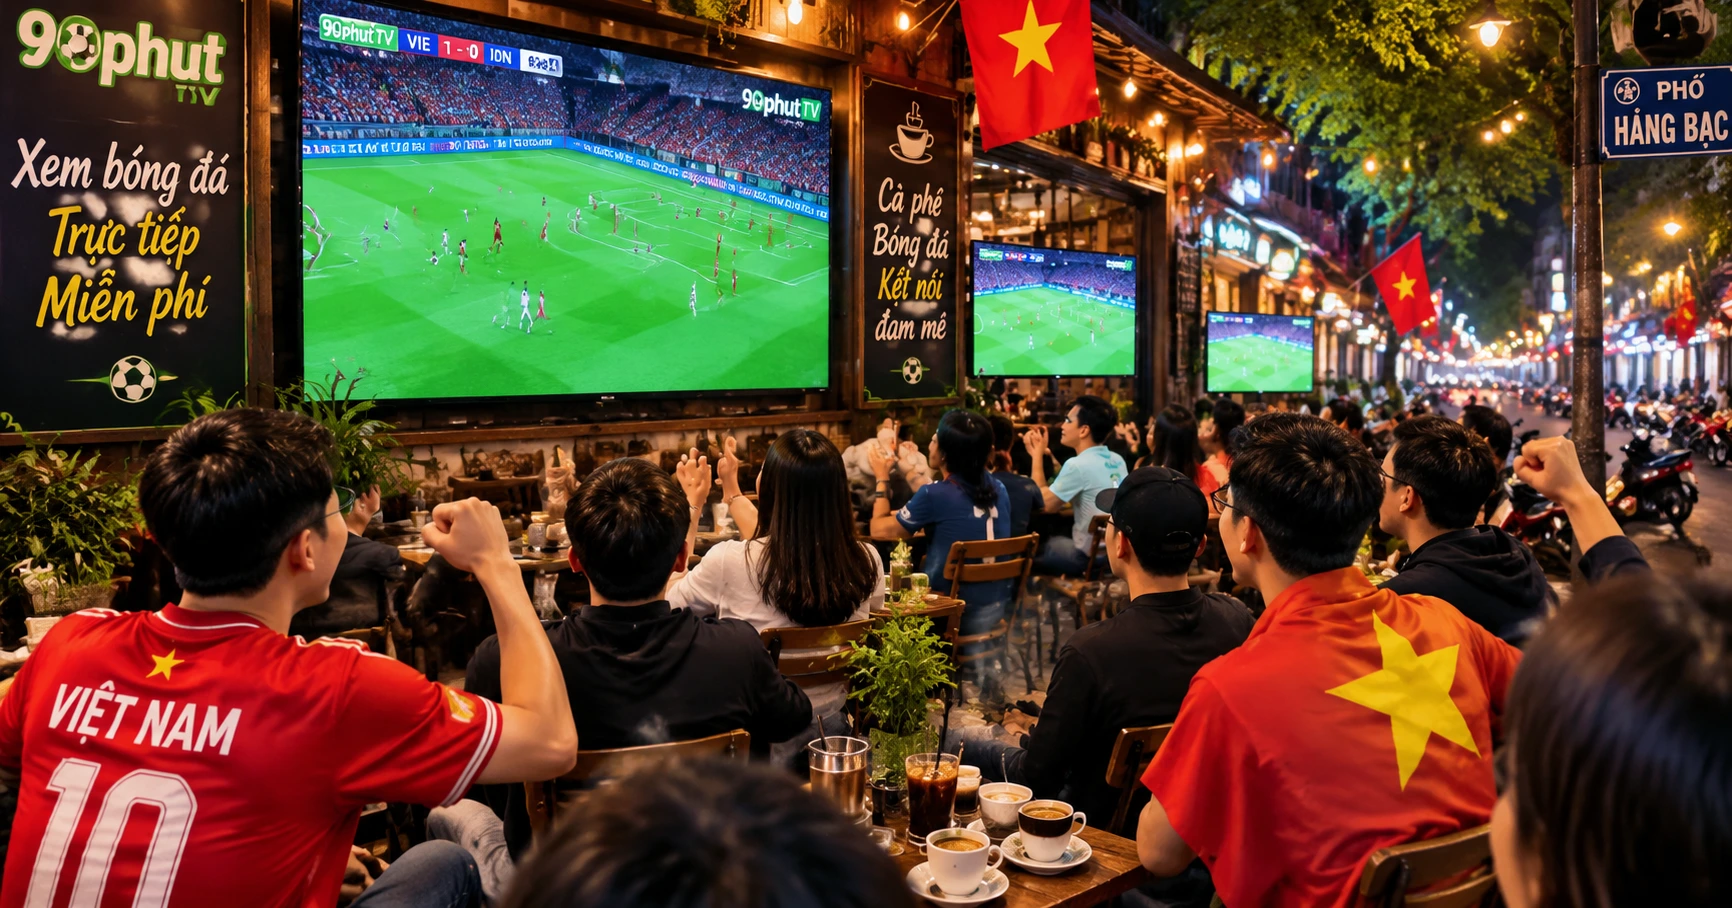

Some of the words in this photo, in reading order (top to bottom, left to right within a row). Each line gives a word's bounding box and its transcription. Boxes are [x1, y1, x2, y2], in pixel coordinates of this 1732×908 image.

[407, 33, 431, 52] VIE
[1684, 109, 1729, 149] BẠC
[10, 137, 93, 189] Xem
[102, 141, 181, 208] bóng
[189, 150, 230, 195] đá
[909, 182, 944, 225] phê
[48, 205, 126, 266] Trực
[872, 222, 921, 268] Bóng
[925, 227, 949, 259] đá
[35, 268, 139, 328] Miễn
[146, 270, 212, 337] phí
[874, 308, 916, 341] đam
[920, 311, 947, 340] mê
[48, 679, 140, 745] VIỆT
[132, 699, 242, 757] NAM
[22, 757, 198, 908] 10
